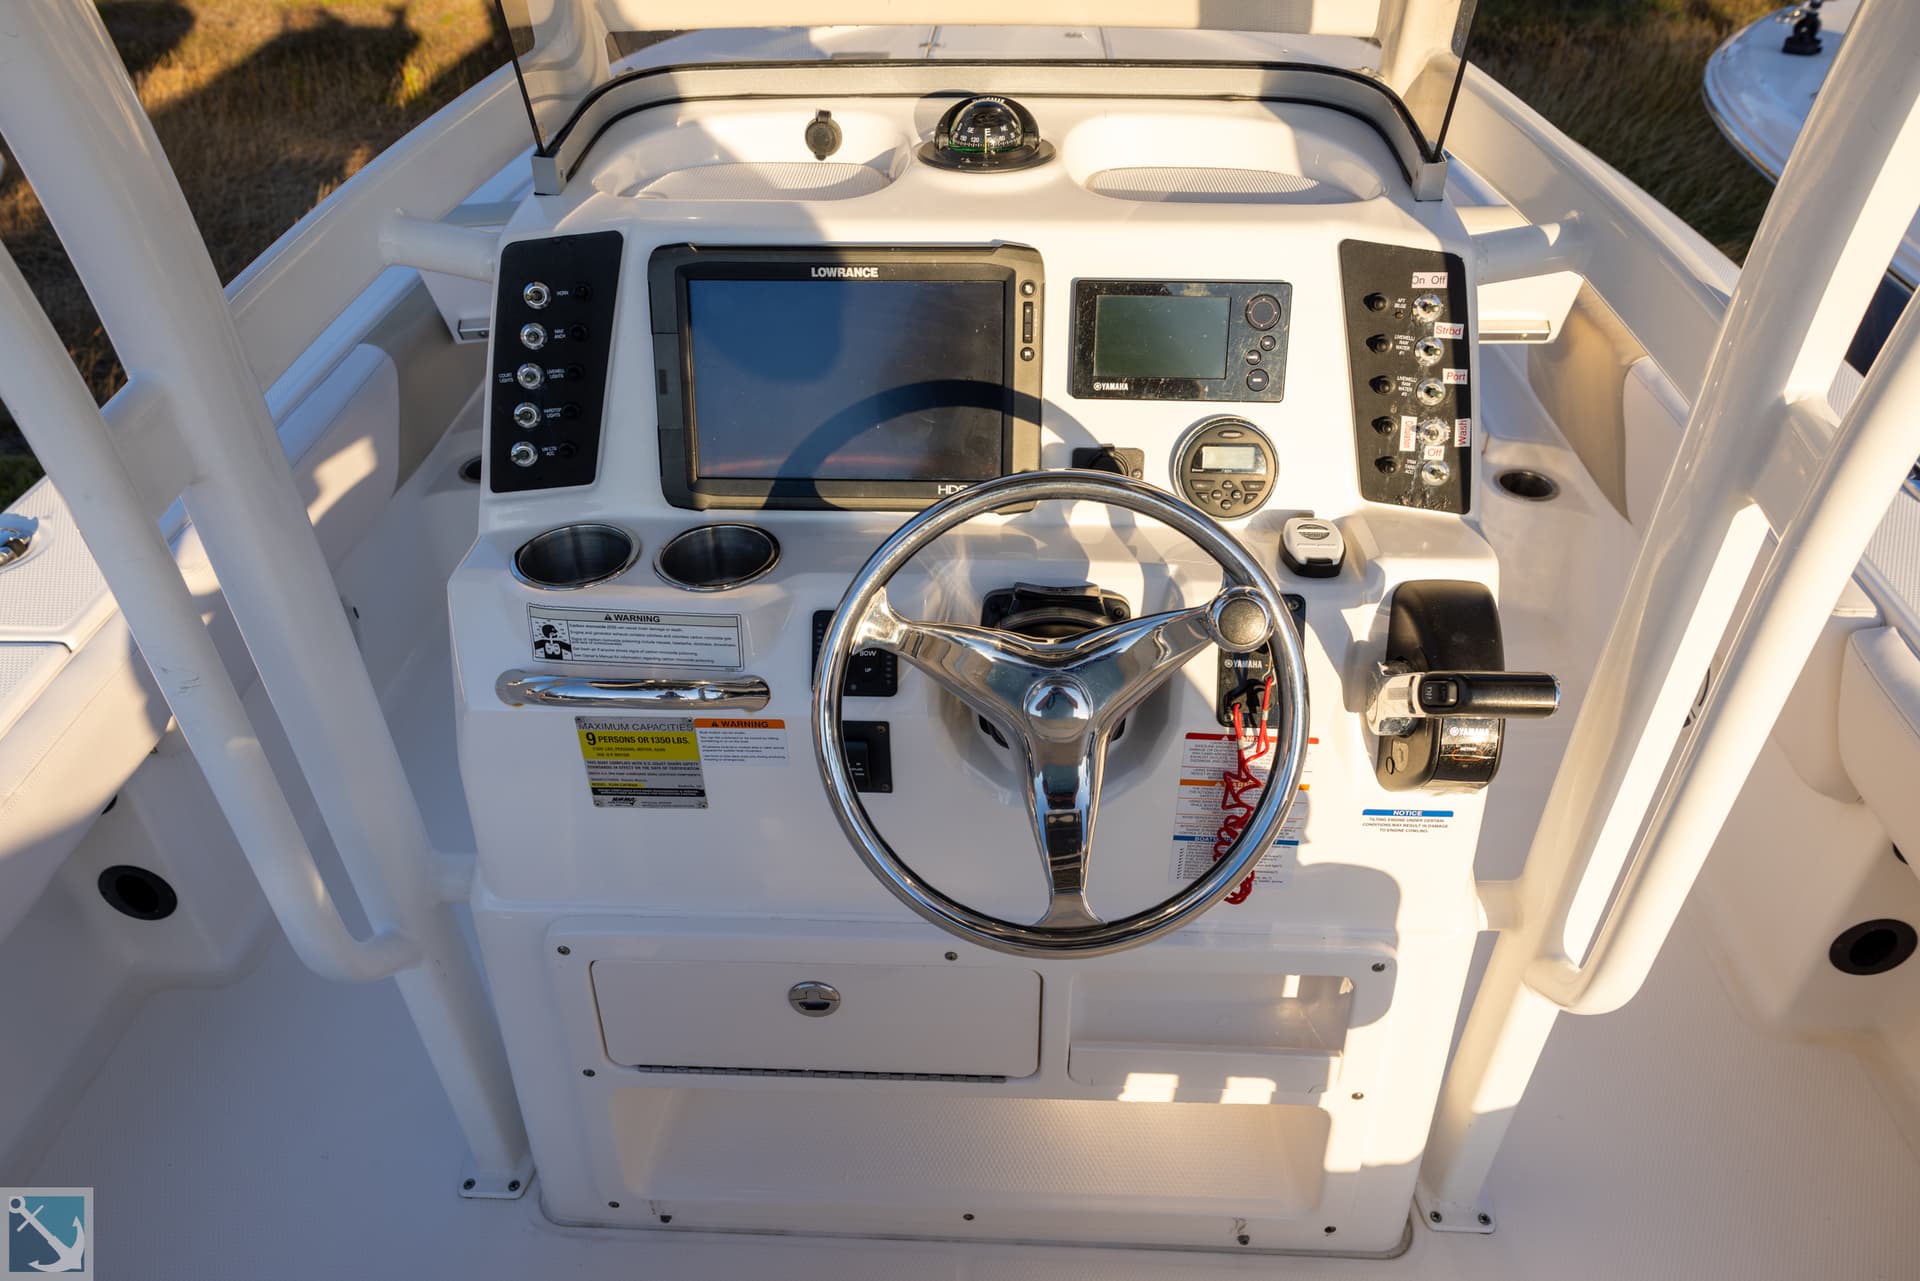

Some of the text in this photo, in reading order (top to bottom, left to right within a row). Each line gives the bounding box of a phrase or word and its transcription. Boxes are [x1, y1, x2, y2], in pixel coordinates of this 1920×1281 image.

[984, 128, 992, 136] E
[811, 267, 879, 278] LOWRANCE
[1412, 275, 1446, 285] On Off
[1435, 325, 1462, 336] Strbd
[1446, 371, 1466, 381] Port
[1101, 382, 1129, 391] YAMAHA
[1458, 419, 1468, 446] Wash
[1427, 448, 1442, 457] Off
[613, 614, 661, 623] WARNING
[1233, 659, 1263, 669] YAMAHA
[581, 722, 694, 732] MAXIMUM CAPACITIES
[720, 720, 769, 729] WARNING
[1460, 727, 1490, 736] YAMAHA
[585, 732, 597, 746] 9
[598, 735, 636, 744] PERSONS
[637, 736, 650, 744] OR
[651, 736, 671, 745] 1350
[672, 737, 690, 745] LBS.
[1392, 809, 1422, 817] NOTICE
